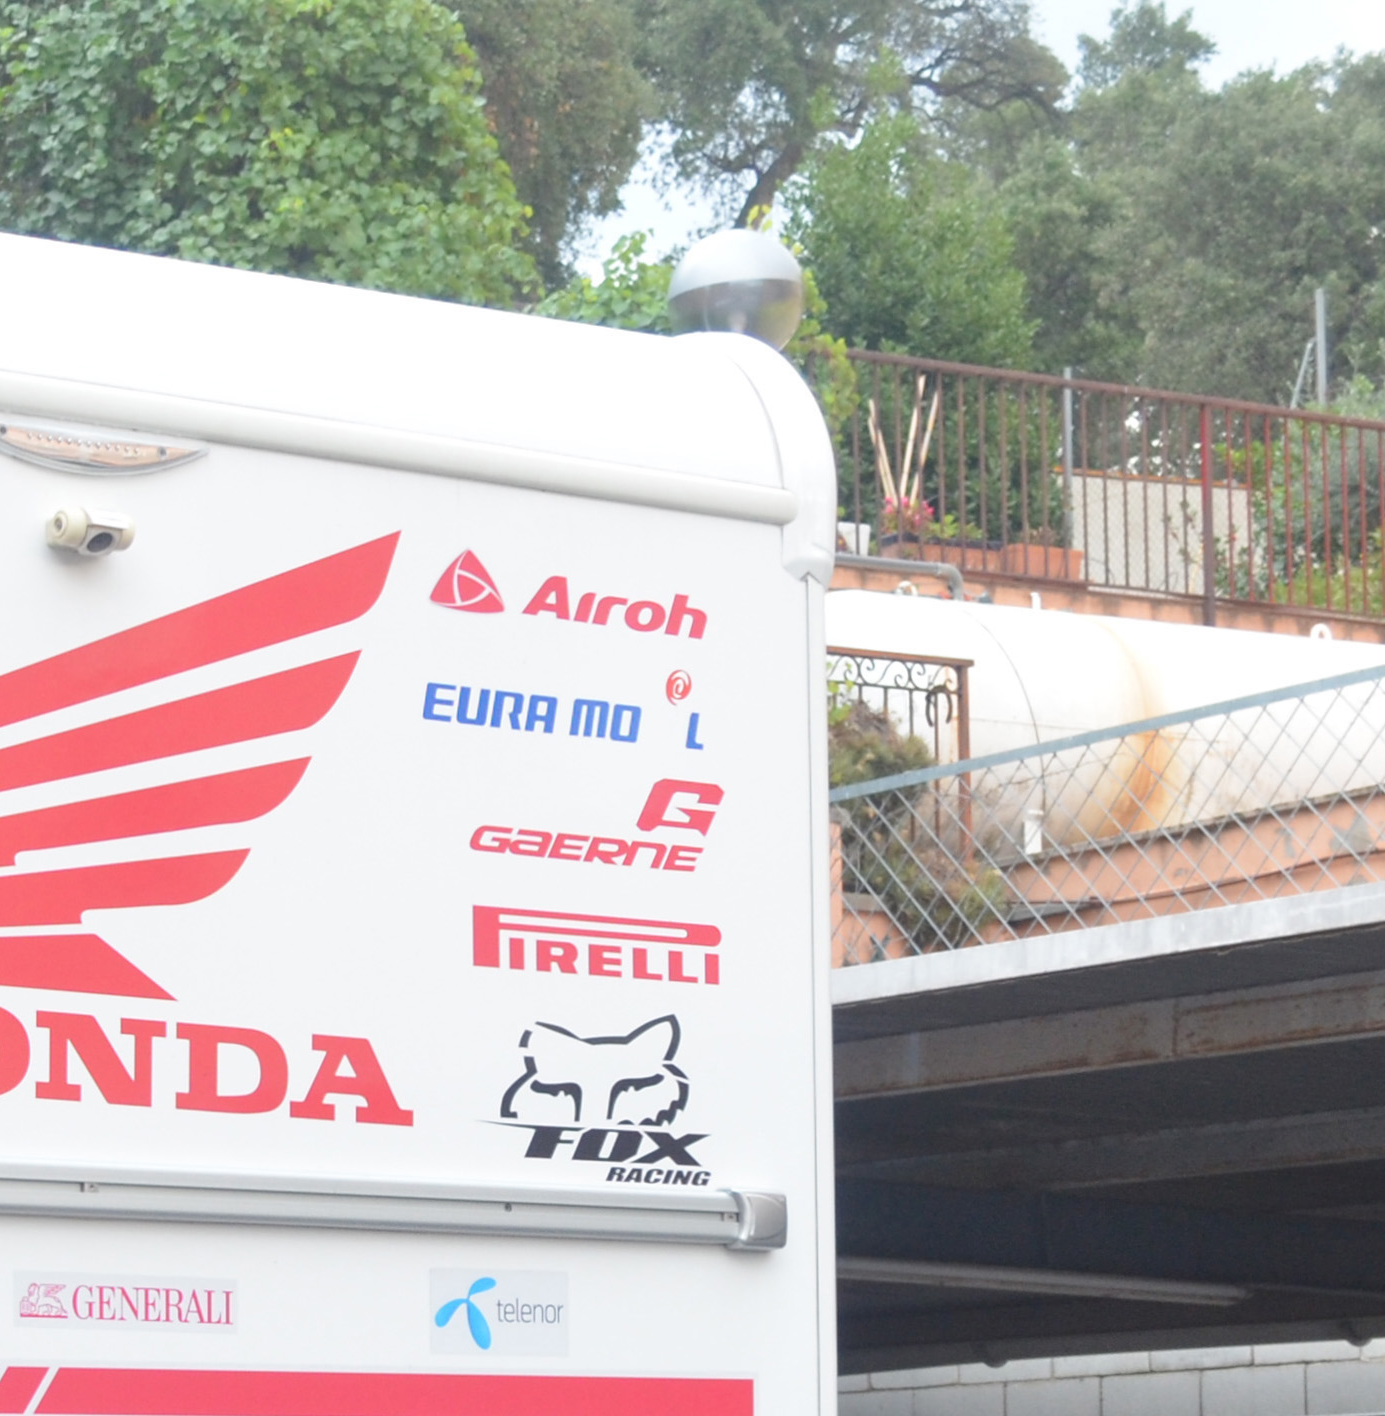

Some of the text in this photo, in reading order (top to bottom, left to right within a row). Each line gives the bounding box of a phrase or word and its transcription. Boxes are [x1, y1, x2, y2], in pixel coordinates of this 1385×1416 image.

[522, 575, 709, 640] Airoh
[422, 681, 559, 734] EURA
[472, 904, 722, 985] PIRELLI
[491, 1122, 712, 1167] FOX
[605, 1166, 712, 1187] RACING
[71, 1281, 235, 1327] GENERALI
[496, 1298, 564, 1326] telenor
